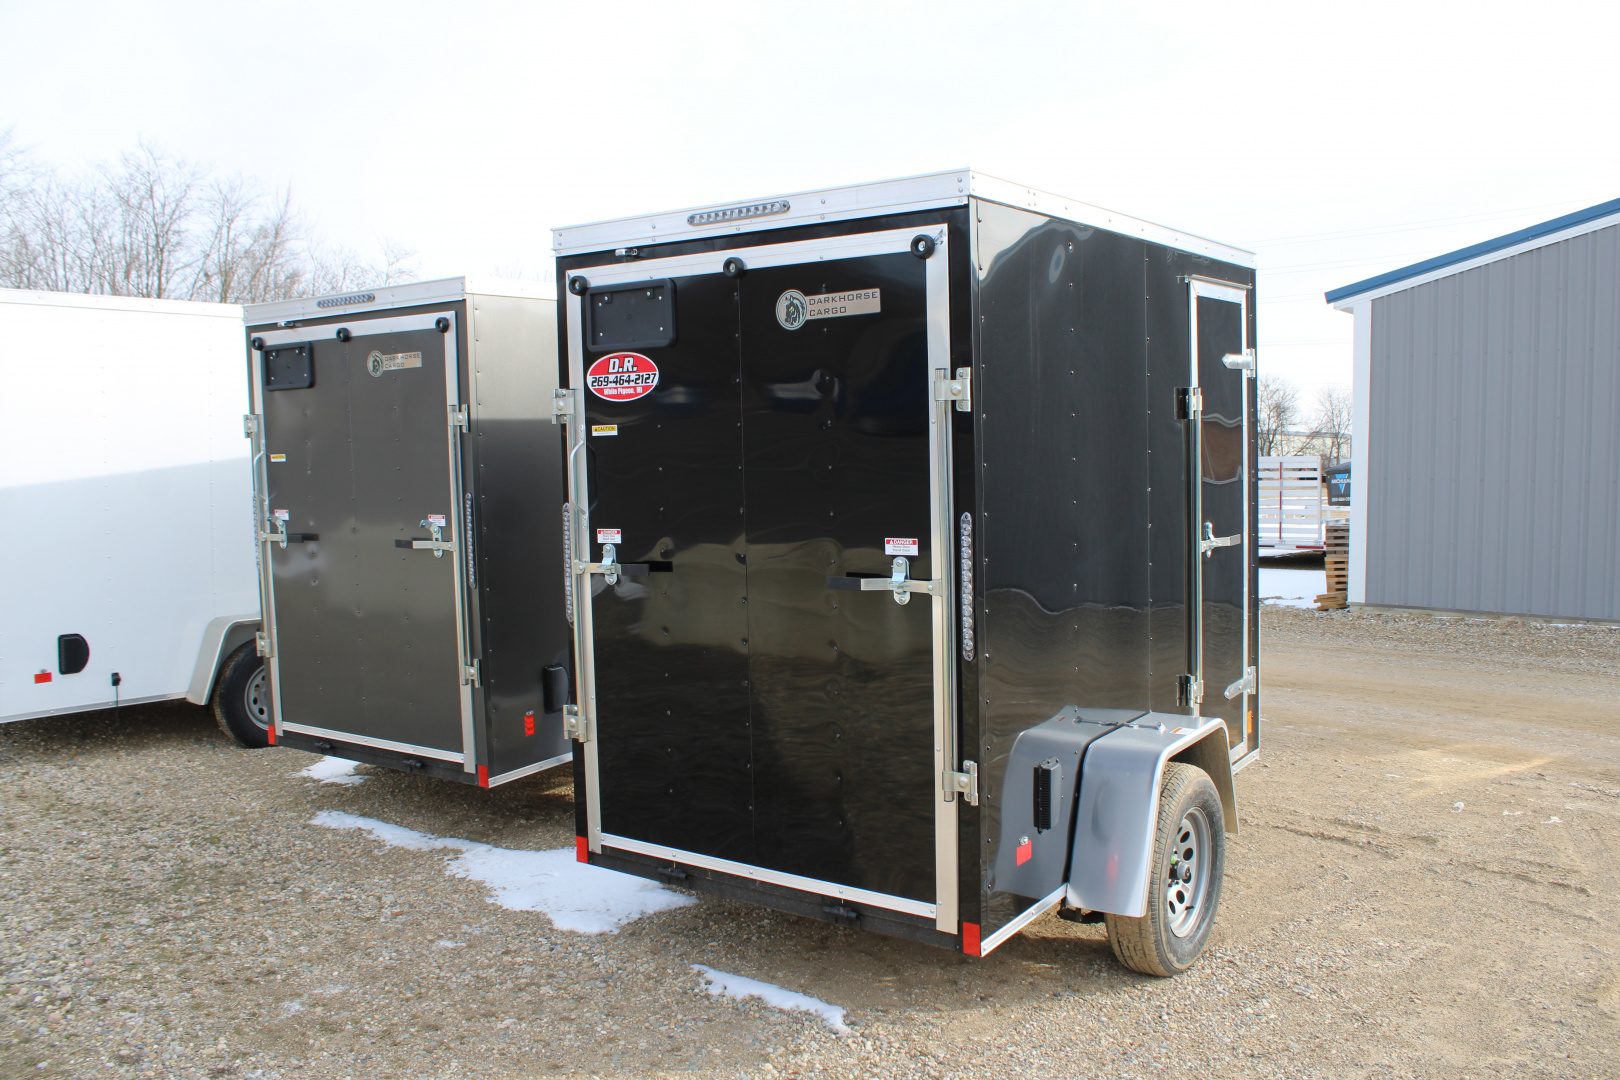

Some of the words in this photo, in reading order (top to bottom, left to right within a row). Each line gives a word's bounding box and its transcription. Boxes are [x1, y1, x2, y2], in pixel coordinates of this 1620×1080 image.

[809, 291, 878, 306] DARKHORSE
[809, 306, 847, 317] CARGO
[384, 353, 421, 361] DARKHORSE
[608, 357, 638, 373] D.R.
[591, 373, 657, 387] 269-464-2127
[603, 387, 617, 395] White
[636, 386, 643, 394] MI
